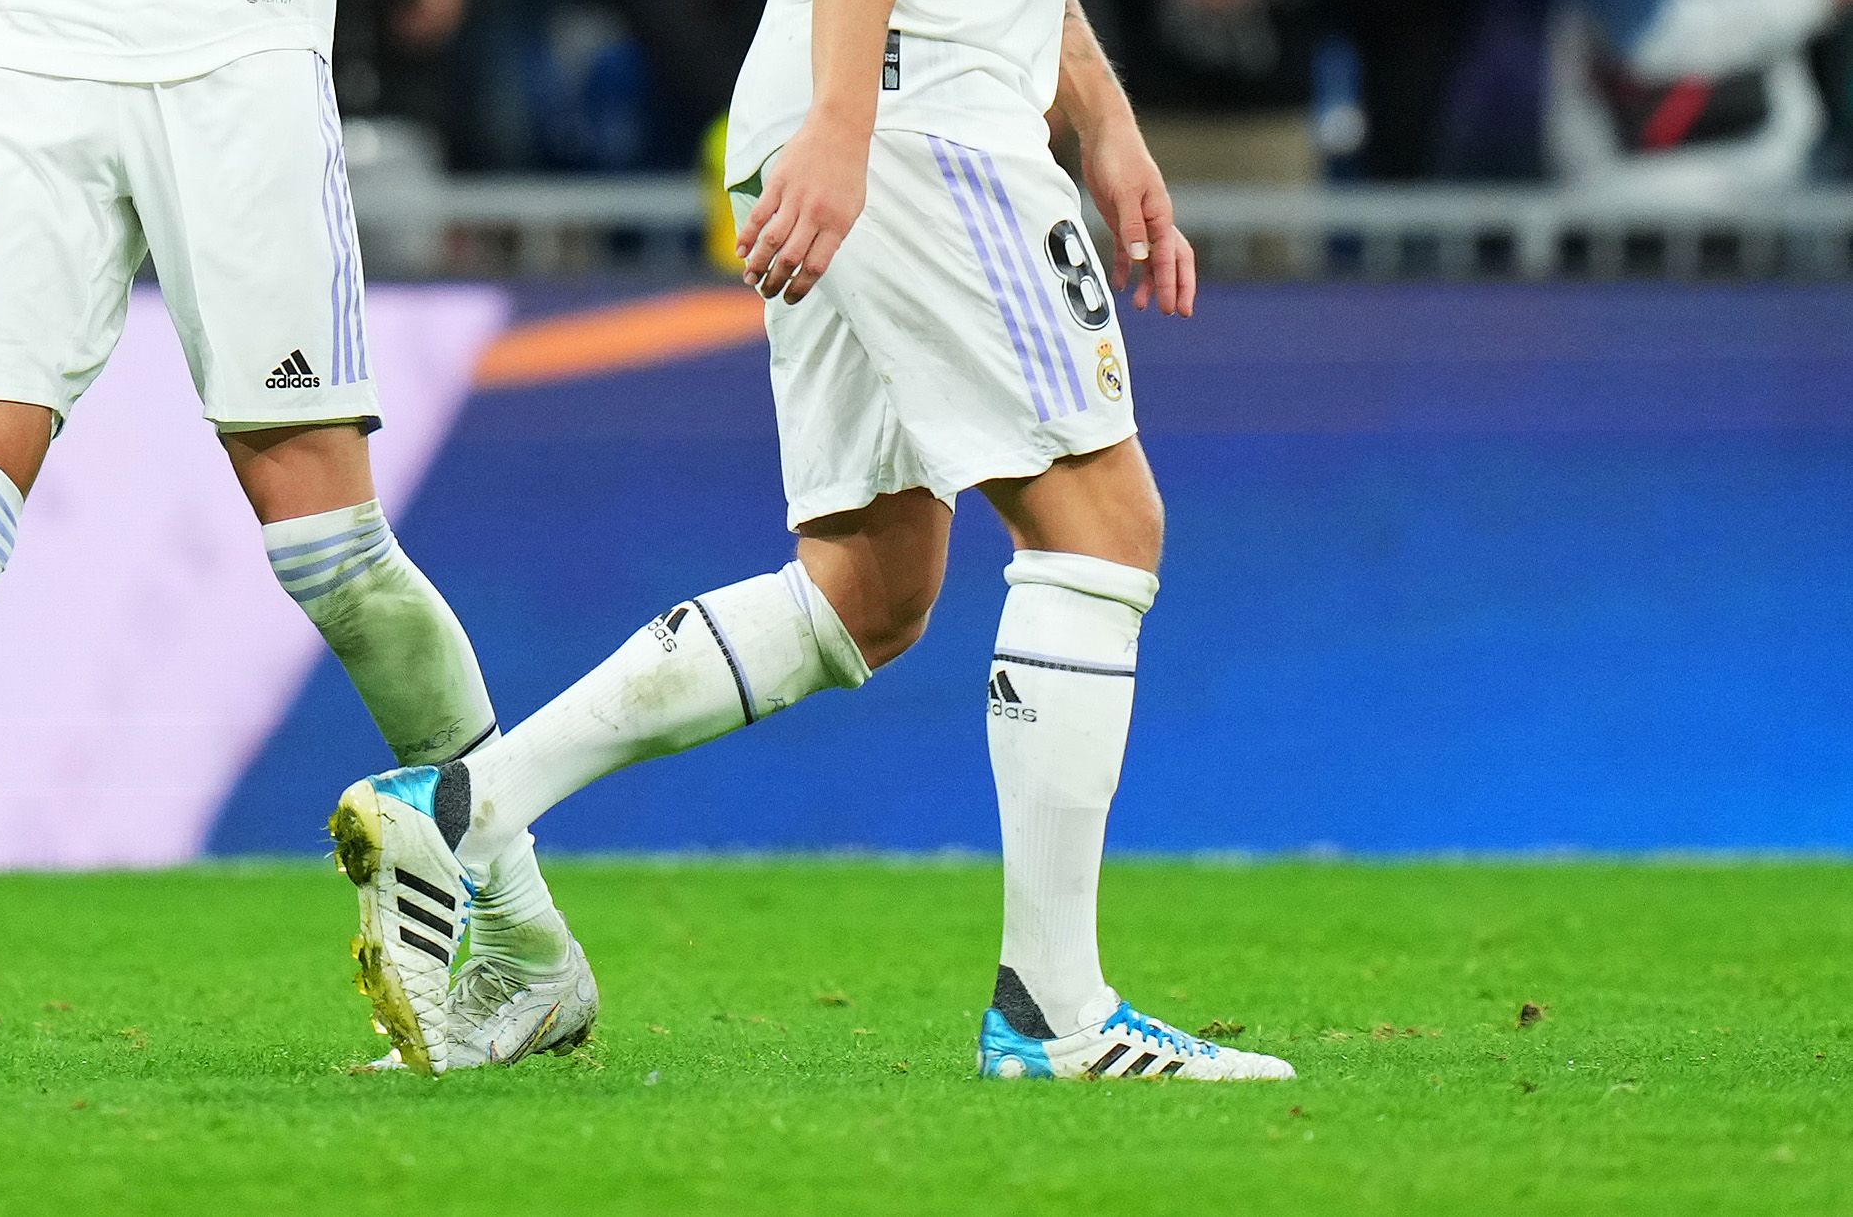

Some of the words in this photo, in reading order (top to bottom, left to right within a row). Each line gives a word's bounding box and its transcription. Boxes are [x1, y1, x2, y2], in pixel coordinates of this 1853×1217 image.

[1044, 219, 1110, 331] 8
[265, 375, 320, 389] adidas
[988, 698, 1037, 722] das
